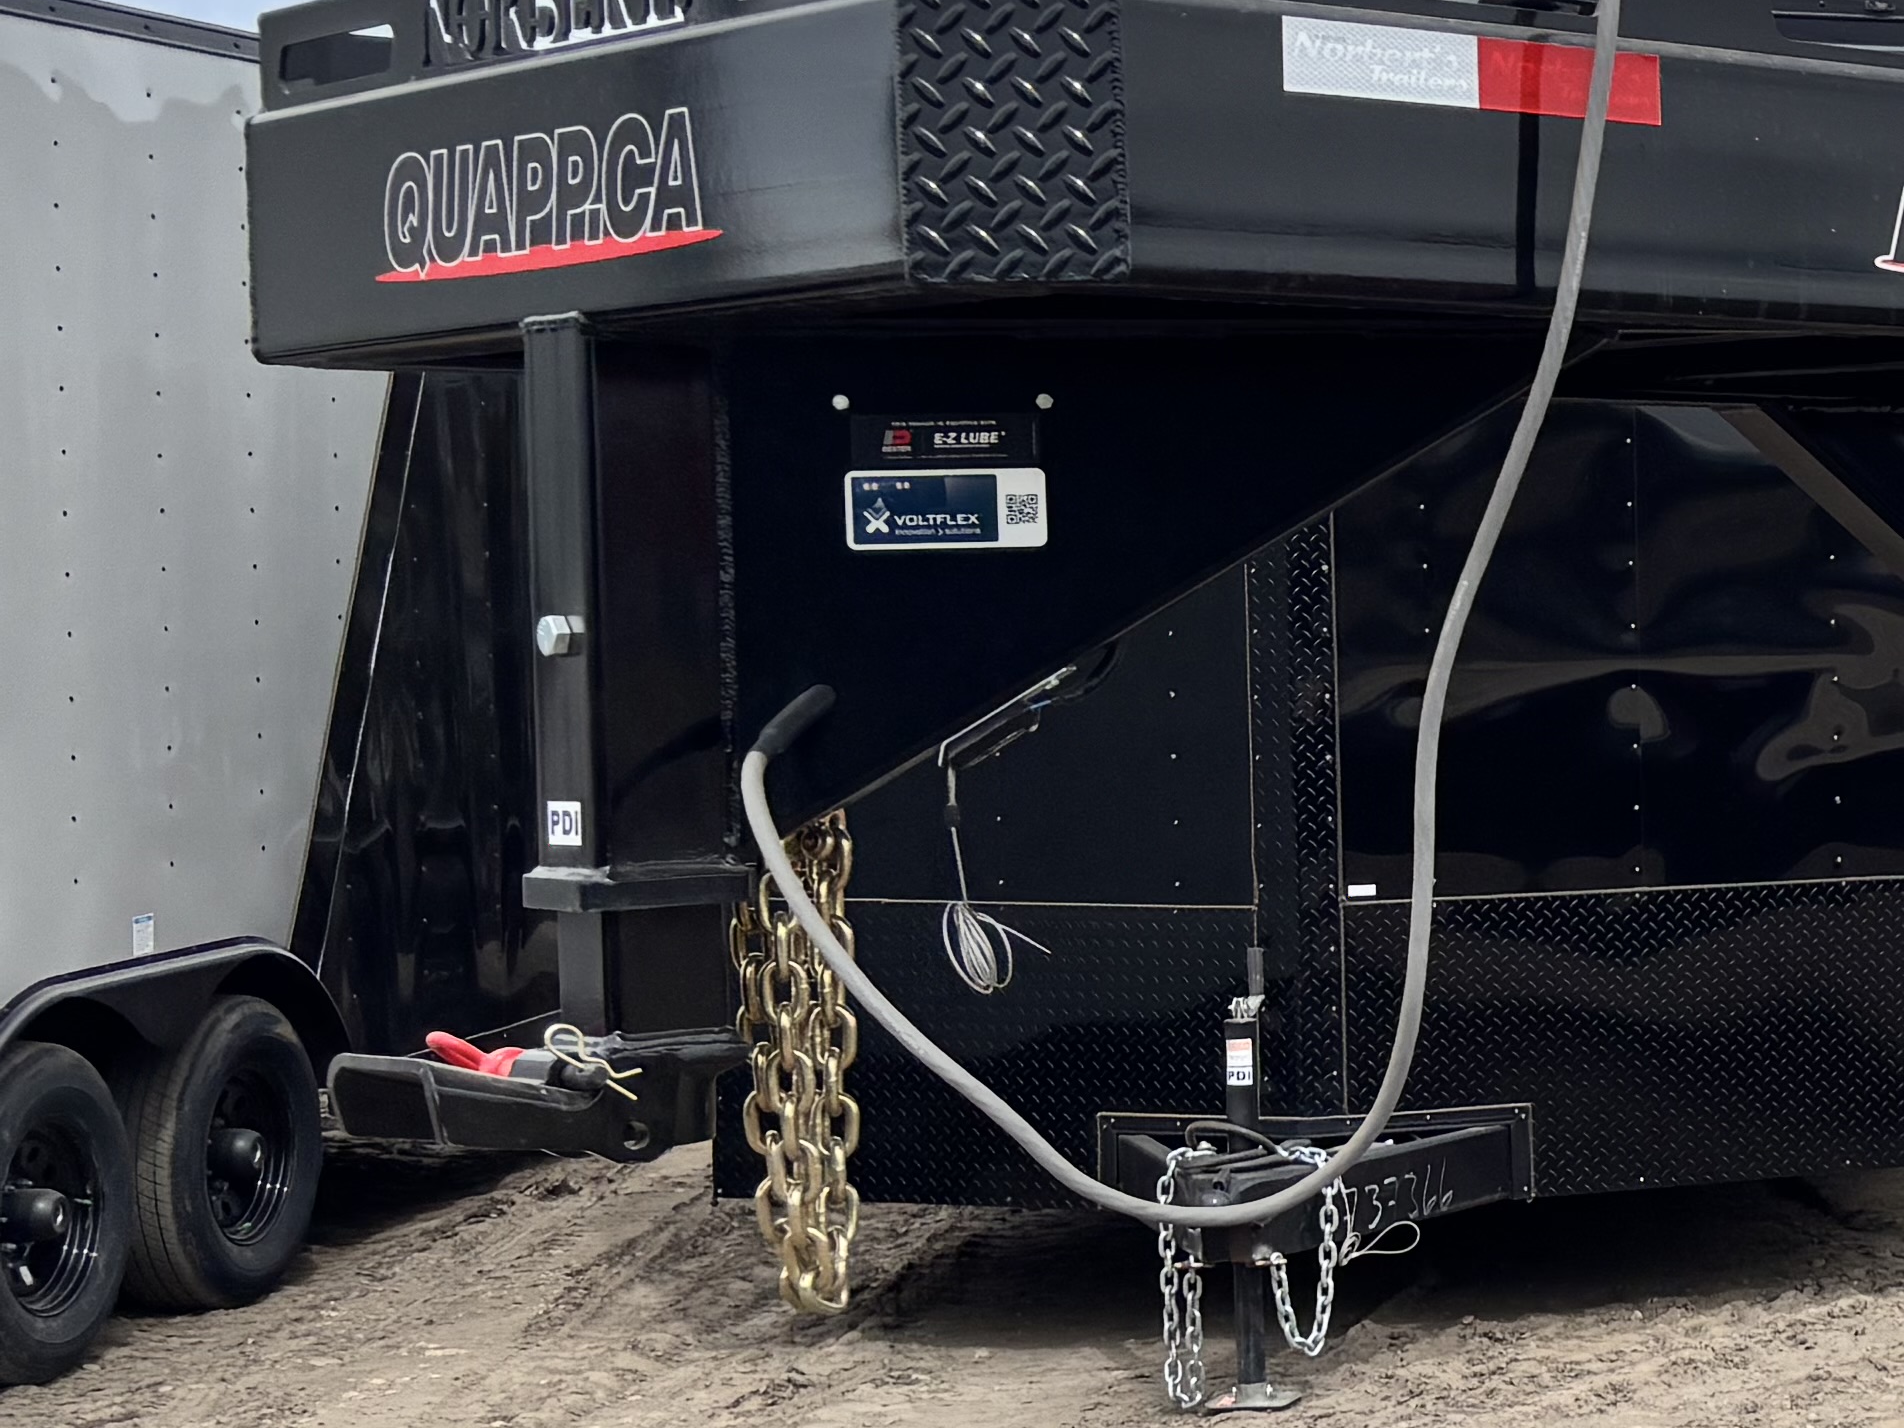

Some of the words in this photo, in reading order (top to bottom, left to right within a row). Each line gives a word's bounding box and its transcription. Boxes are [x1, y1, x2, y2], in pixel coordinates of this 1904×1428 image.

[1369, 64, 1469, 93] Trailers
[383, 106, 704, 280] QUAPP.CA
[960, 431, 999, 444] LUBE
[894, 513, 981, 526] VOLTFLEX
[550, 810, 579, 836] PDI
[1228, 1070, 1251, 1081] PDI
